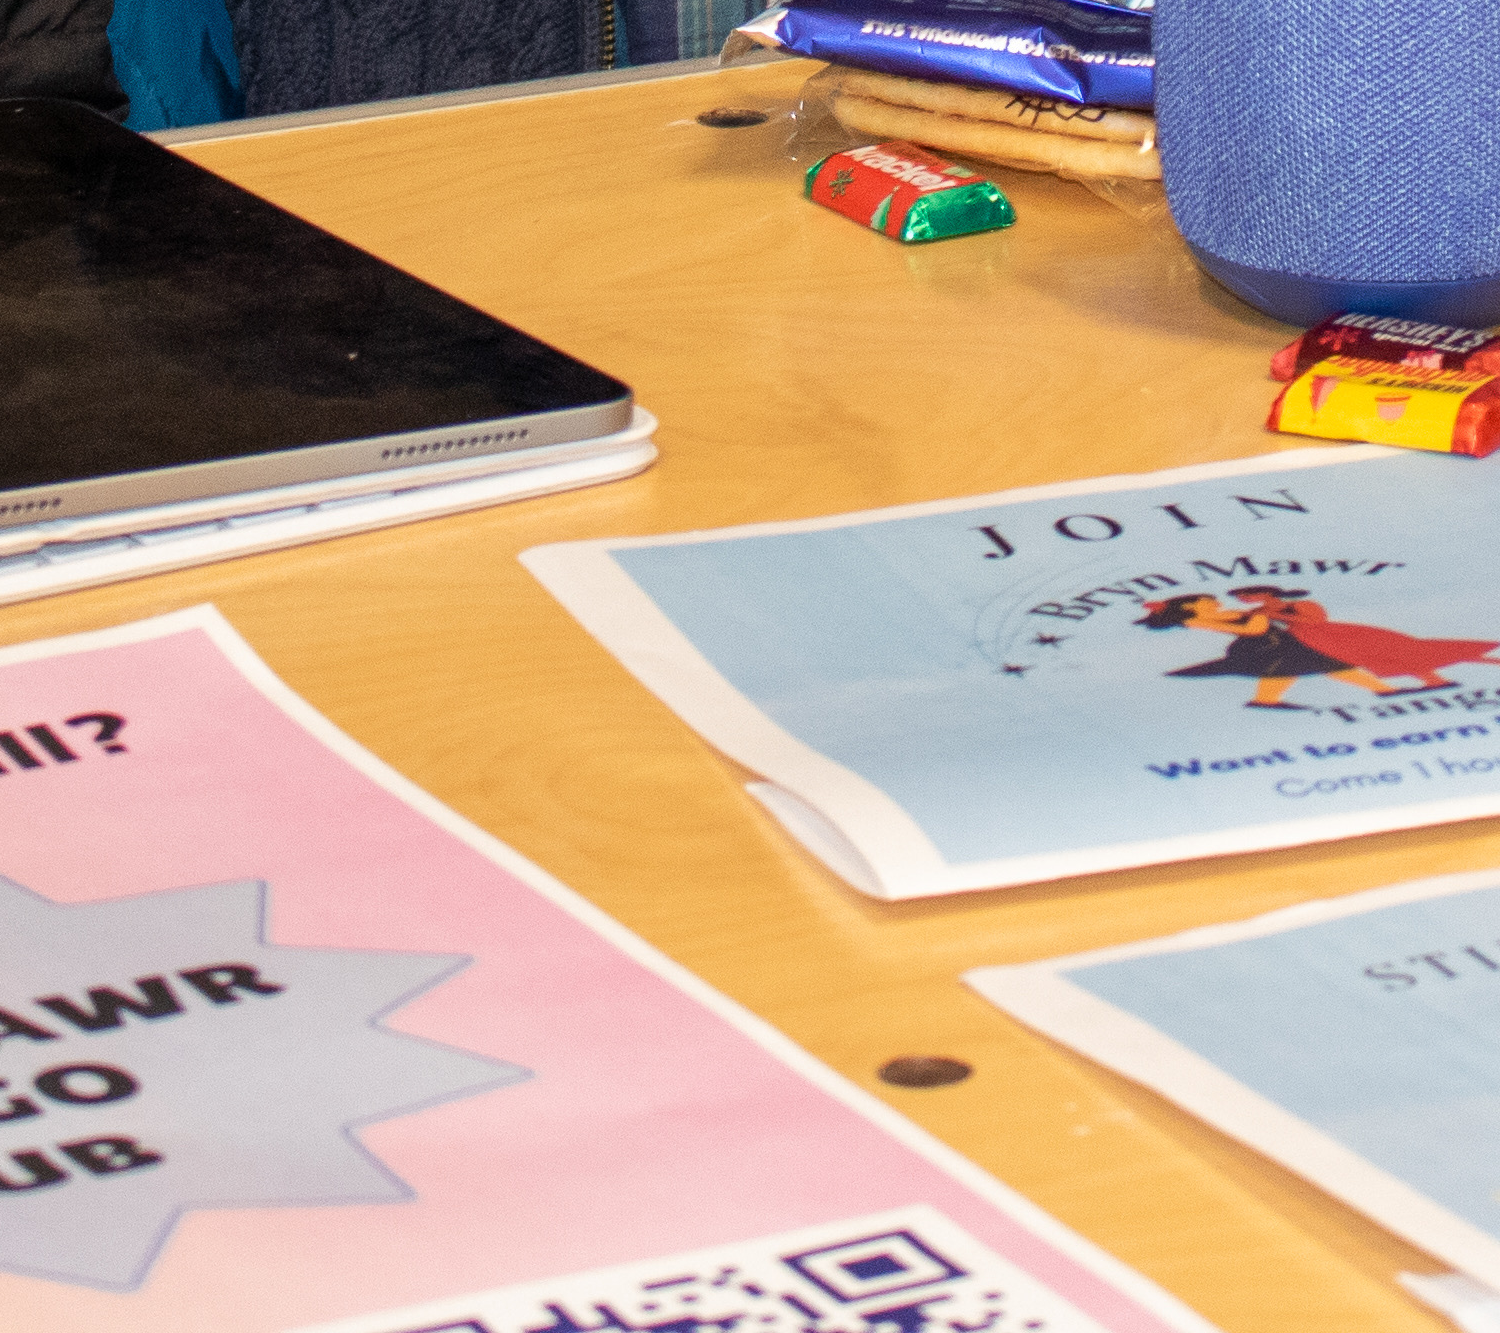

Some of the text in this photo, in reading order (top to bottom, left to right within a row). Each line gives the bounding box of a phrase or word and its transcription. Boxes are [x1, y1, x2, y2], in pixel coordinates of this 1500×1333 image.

[968, 488, 1310, 561] JOIN
[1029, 555, 1407, 623] Bryn Mawr
[1144, 747, 1296, 780] Want
[1304, 740, 1358, 760] to
[1370, 721, 1490, 750] earn
[1274, 769, 1402, 800] Come
